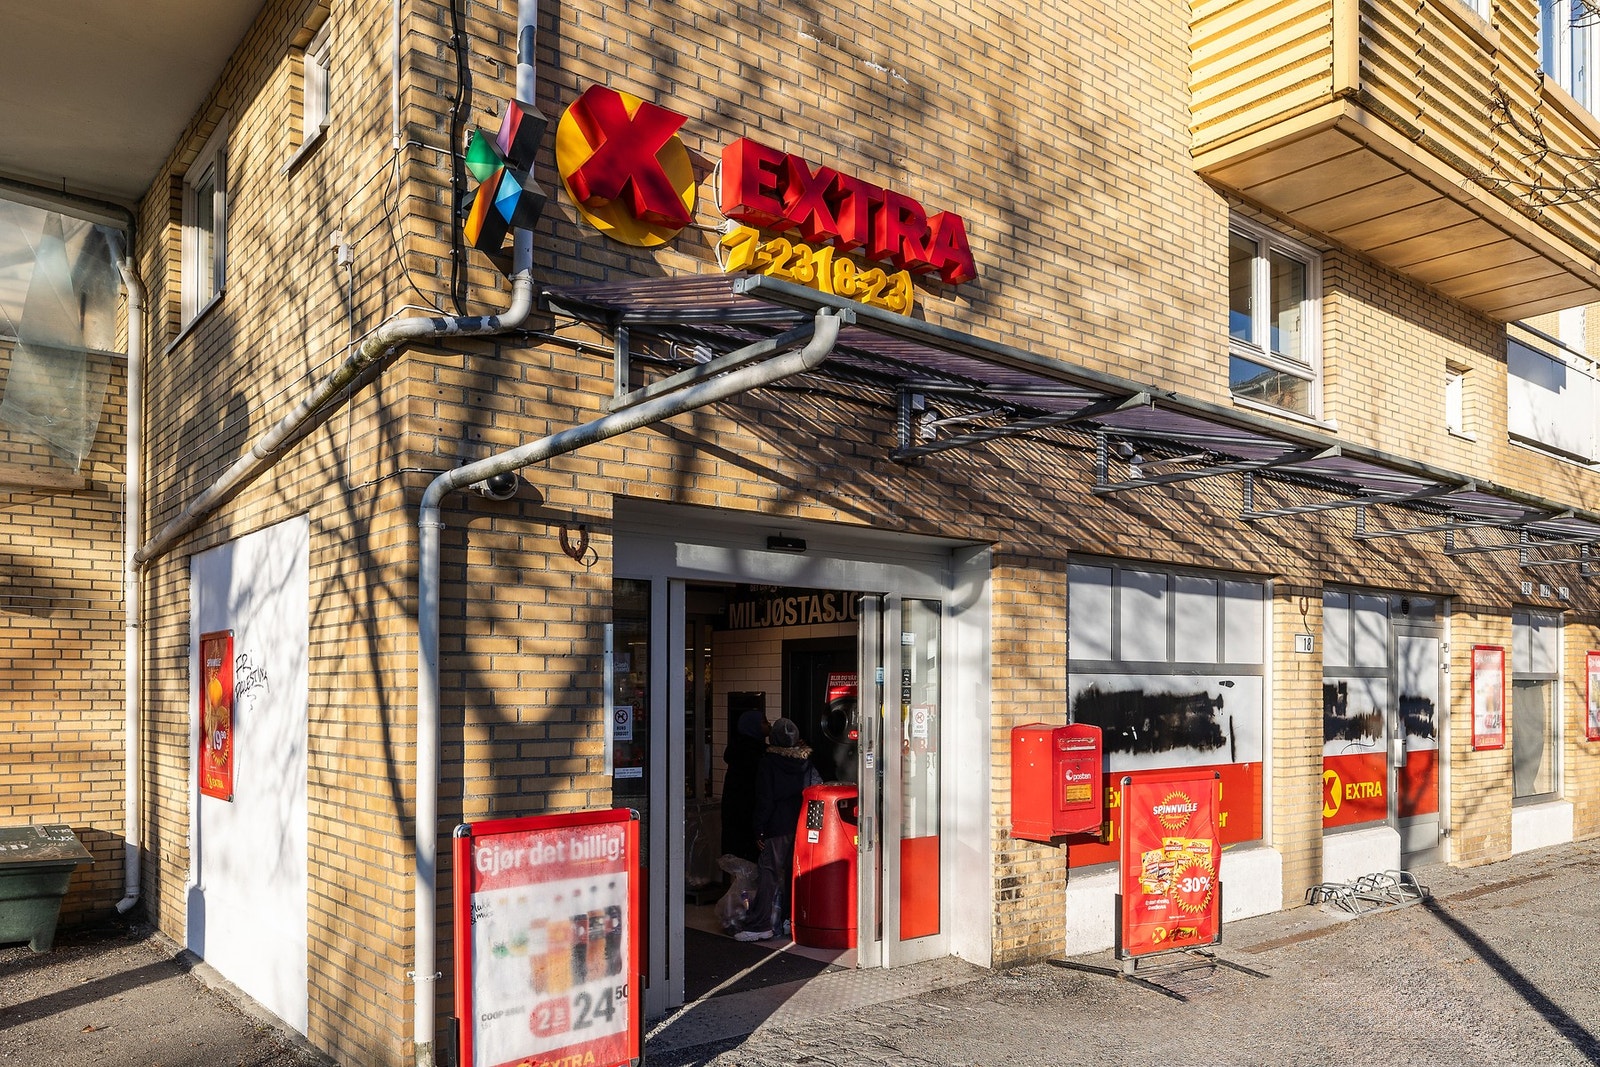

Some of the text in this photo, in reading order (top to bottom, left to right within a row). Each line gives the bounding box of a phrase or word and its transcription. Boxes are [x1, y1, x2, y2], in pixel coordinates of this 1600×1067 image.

[721, 137, 977, 285] EXTRA
[1303, 637, 1312, 652] 18
[1073, 773, 1092, 782] posten
[1345, 781, 1383, 800] EXTRA
[1152, 803, 1198, 815] SPINNVILLE
[476, 832, 626, 877] Gjør det billig!
[1177, 876, 1211, 893] -30%
[481, 1009, 504, 1022] COOP
[573, 986, 616, 1031] 24
[535, 1007, 550, 1031] 2
